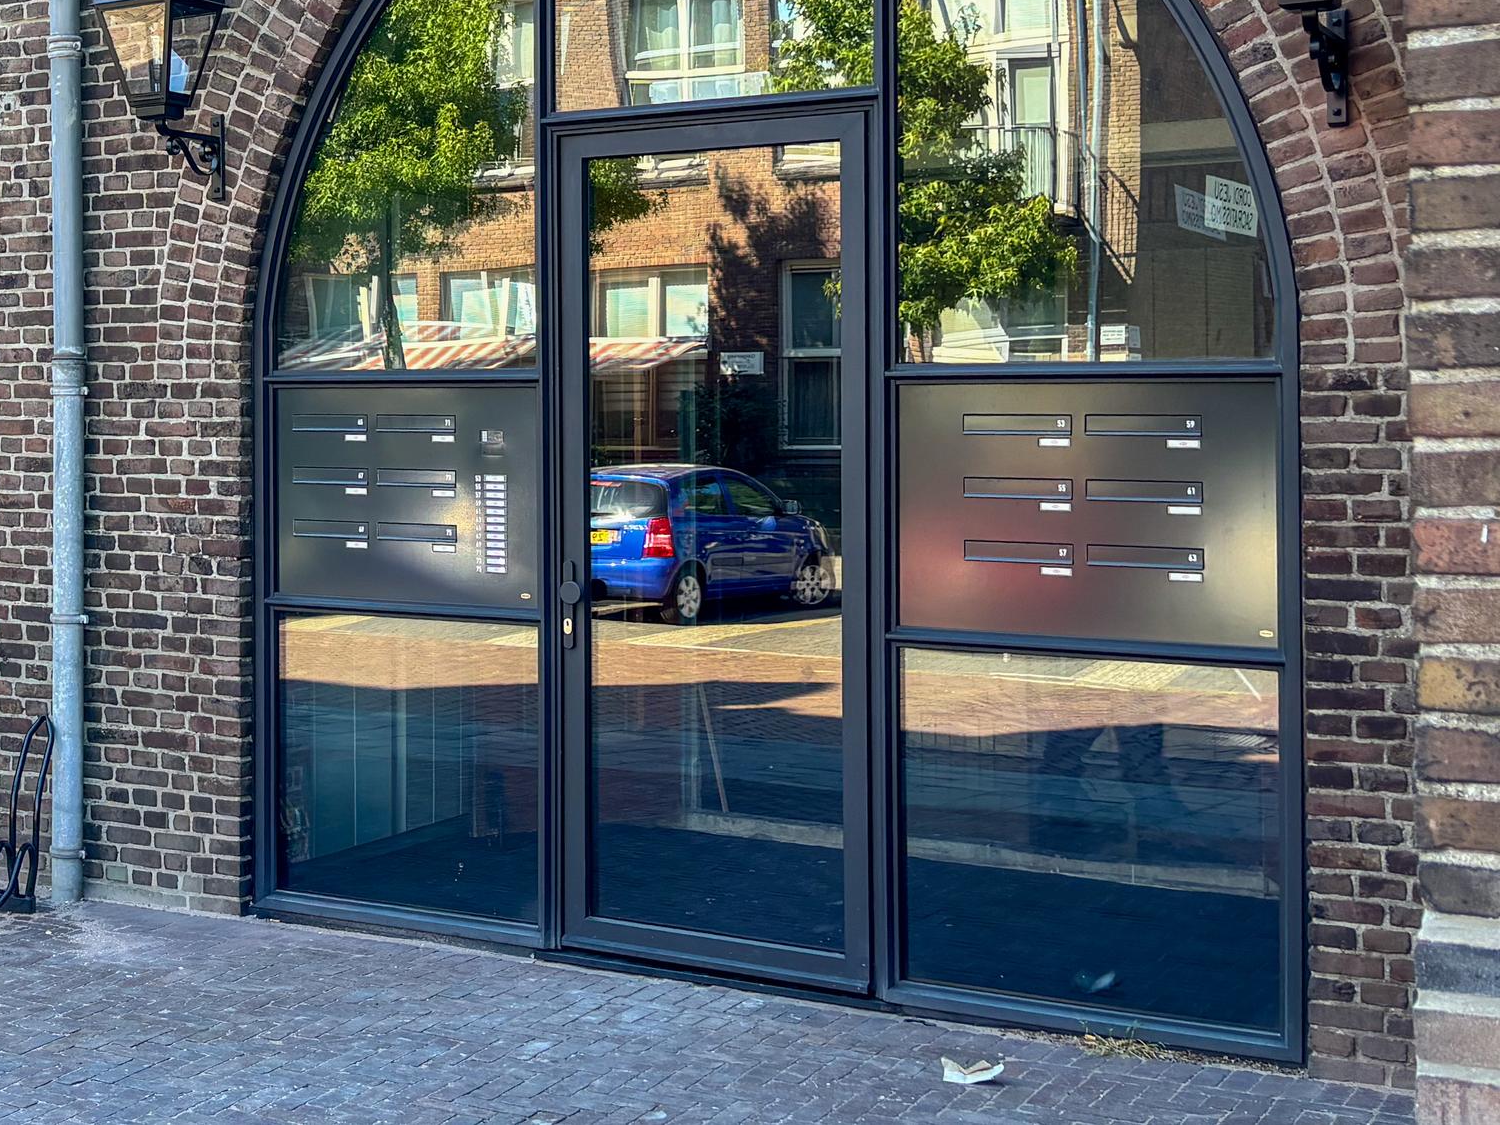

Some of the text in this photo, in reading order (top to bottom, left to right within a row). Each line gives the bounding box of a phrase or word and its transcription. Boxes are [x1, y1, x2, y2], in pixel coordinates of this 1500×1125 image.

[1057, 419, 1065, 428] 53
[1186, 420, 1195, 428] 59
[1058, 484, 1066, 492] 55
[1187, 487, 1196, 495] 61
[1059, 548, 1067, 557] 57
[1188, 554, 1197, 562] 63
